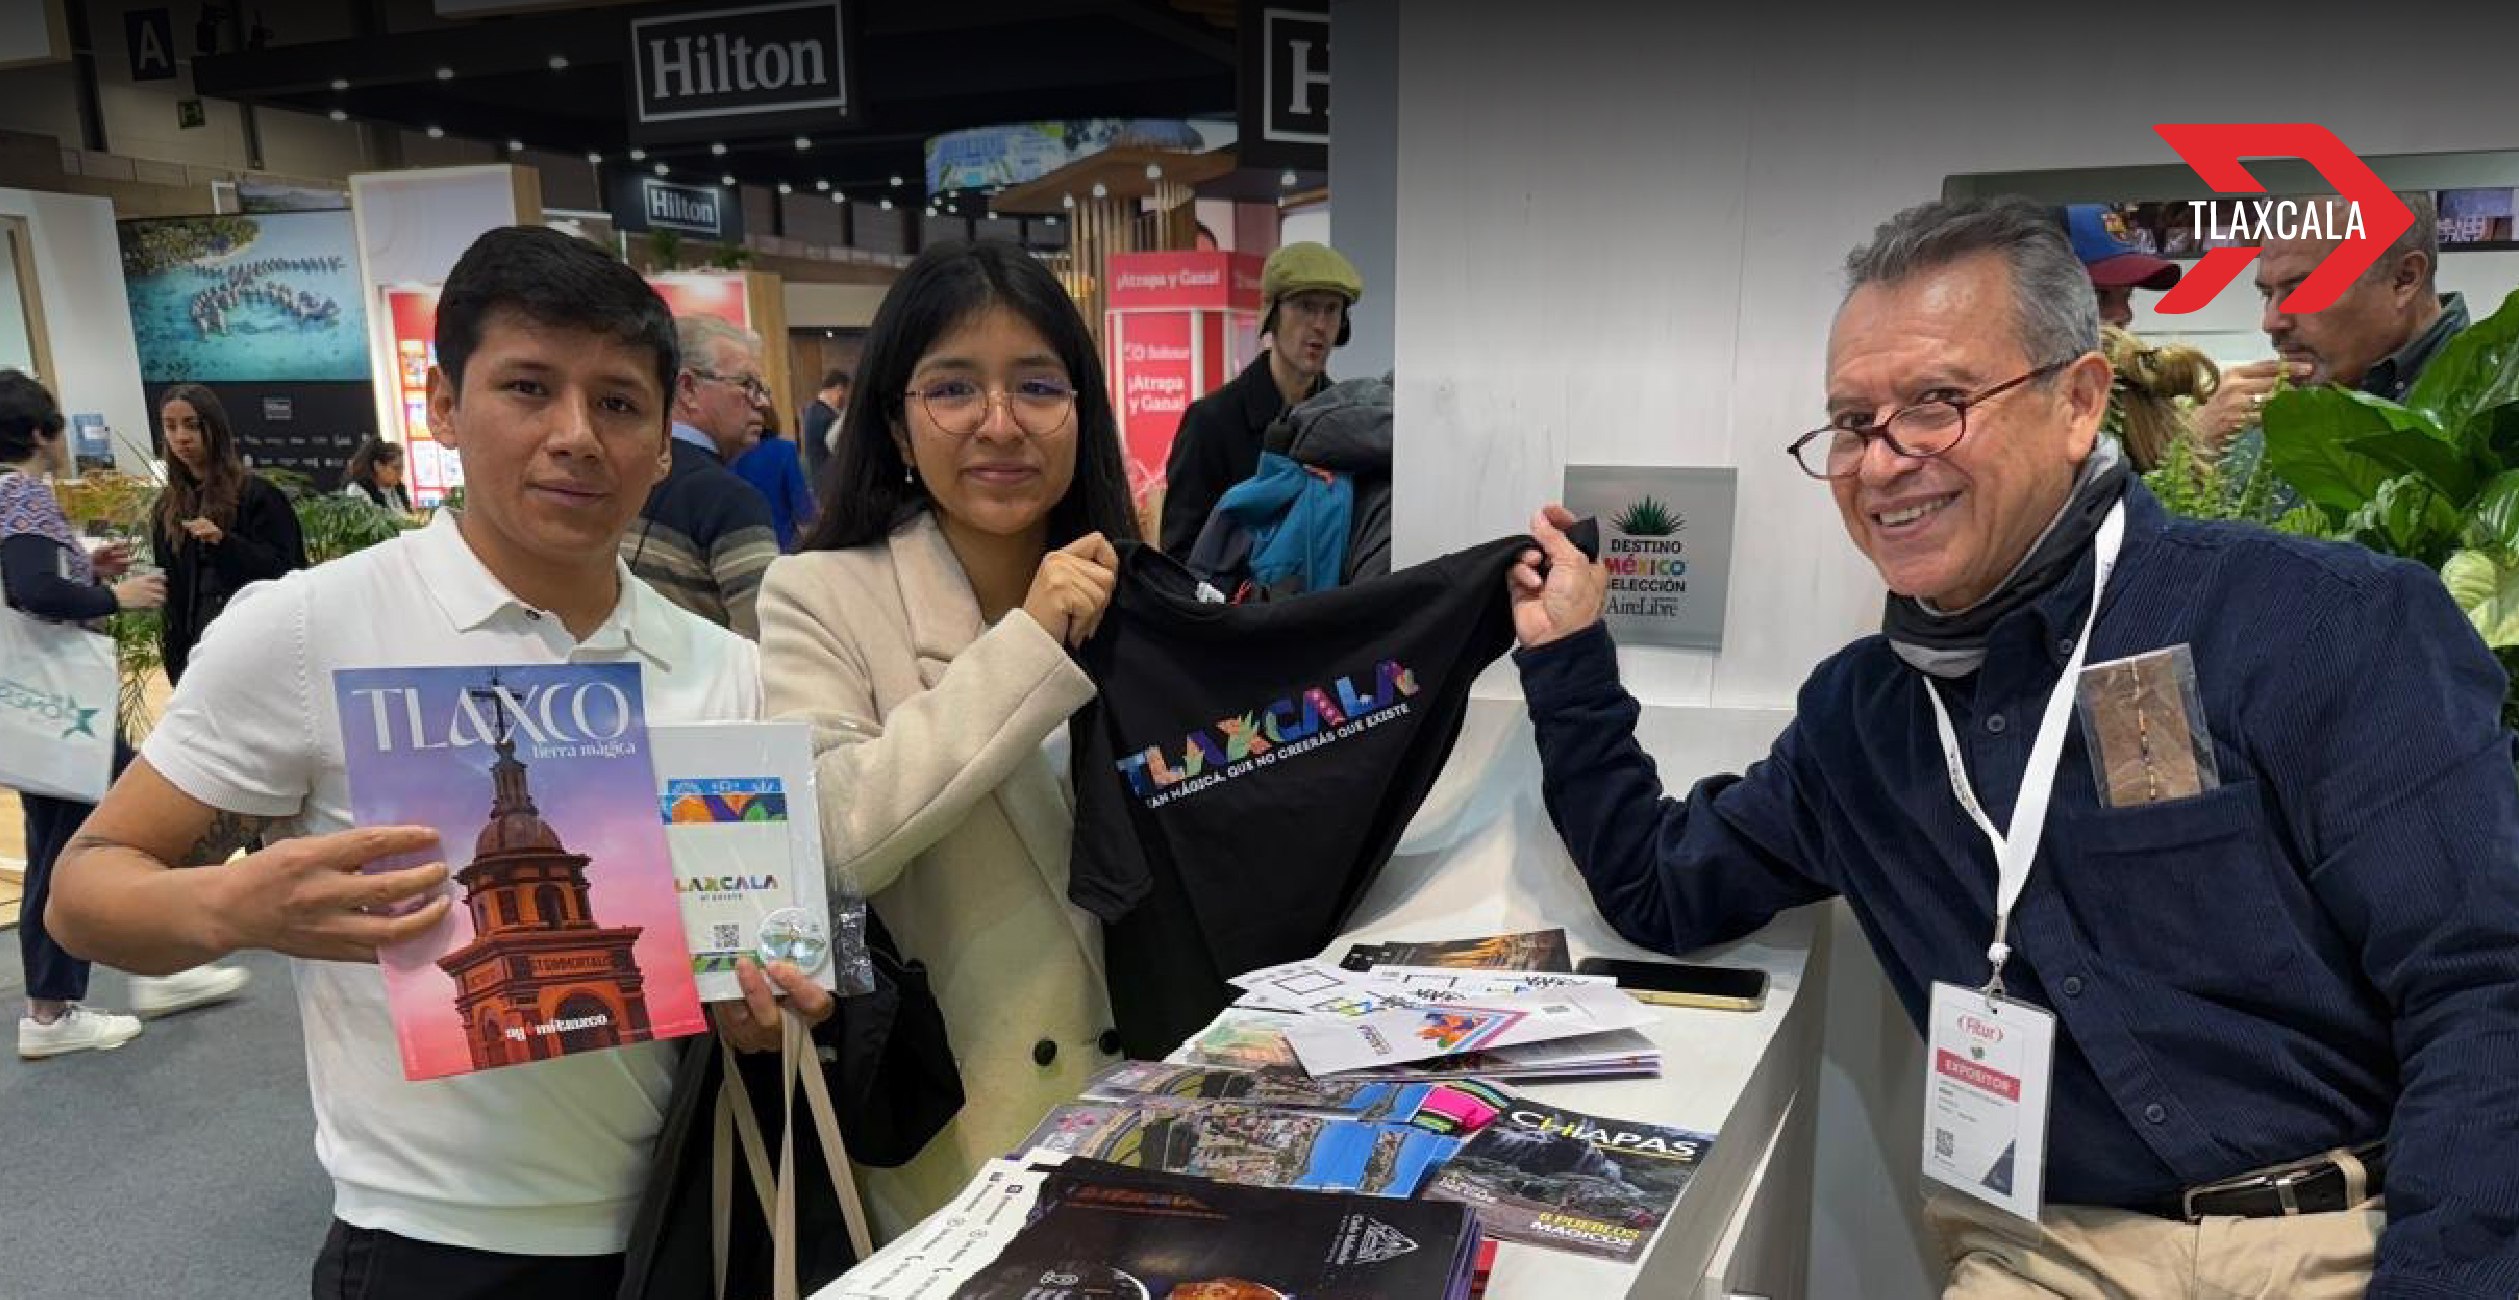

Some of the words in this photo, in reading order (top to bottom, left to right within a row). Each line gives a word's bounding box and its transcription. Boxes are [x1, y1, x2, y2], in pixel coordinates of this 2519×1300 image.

[138, 19, 168, 69] A
[650, 34, 827, 99] Hilton
[651, 188, 715, 223] Hilton
[1611, 538, 1683, 555] DESTINO
[1604, 553, 1687, 577] MÉXICO
[352, 682, 629, 751] TLAXCO
[1116, 659, 1421, 798] TLAXCALA
[531, 743, 576, 759] tierra
[1227, 758, 1254, 779] QUE
[1256, 752, 1276, 769] NO
[1277, 730, 1337, 762] CREERÁS
[1338, 718, 1364, 739] QUE
[1364, 702, 1411, 730] EXISTE
[673, 873, 779, 894] LAXCALA
[1967, 1016, 1995, 1040] Fitur
[1946, 1059, 2014, 1092] EXPOSITOR
[1511, 1110, 1699, 1157] CHIAPAS
[1556, 1214, 1640, 1240] PUEBLOS
